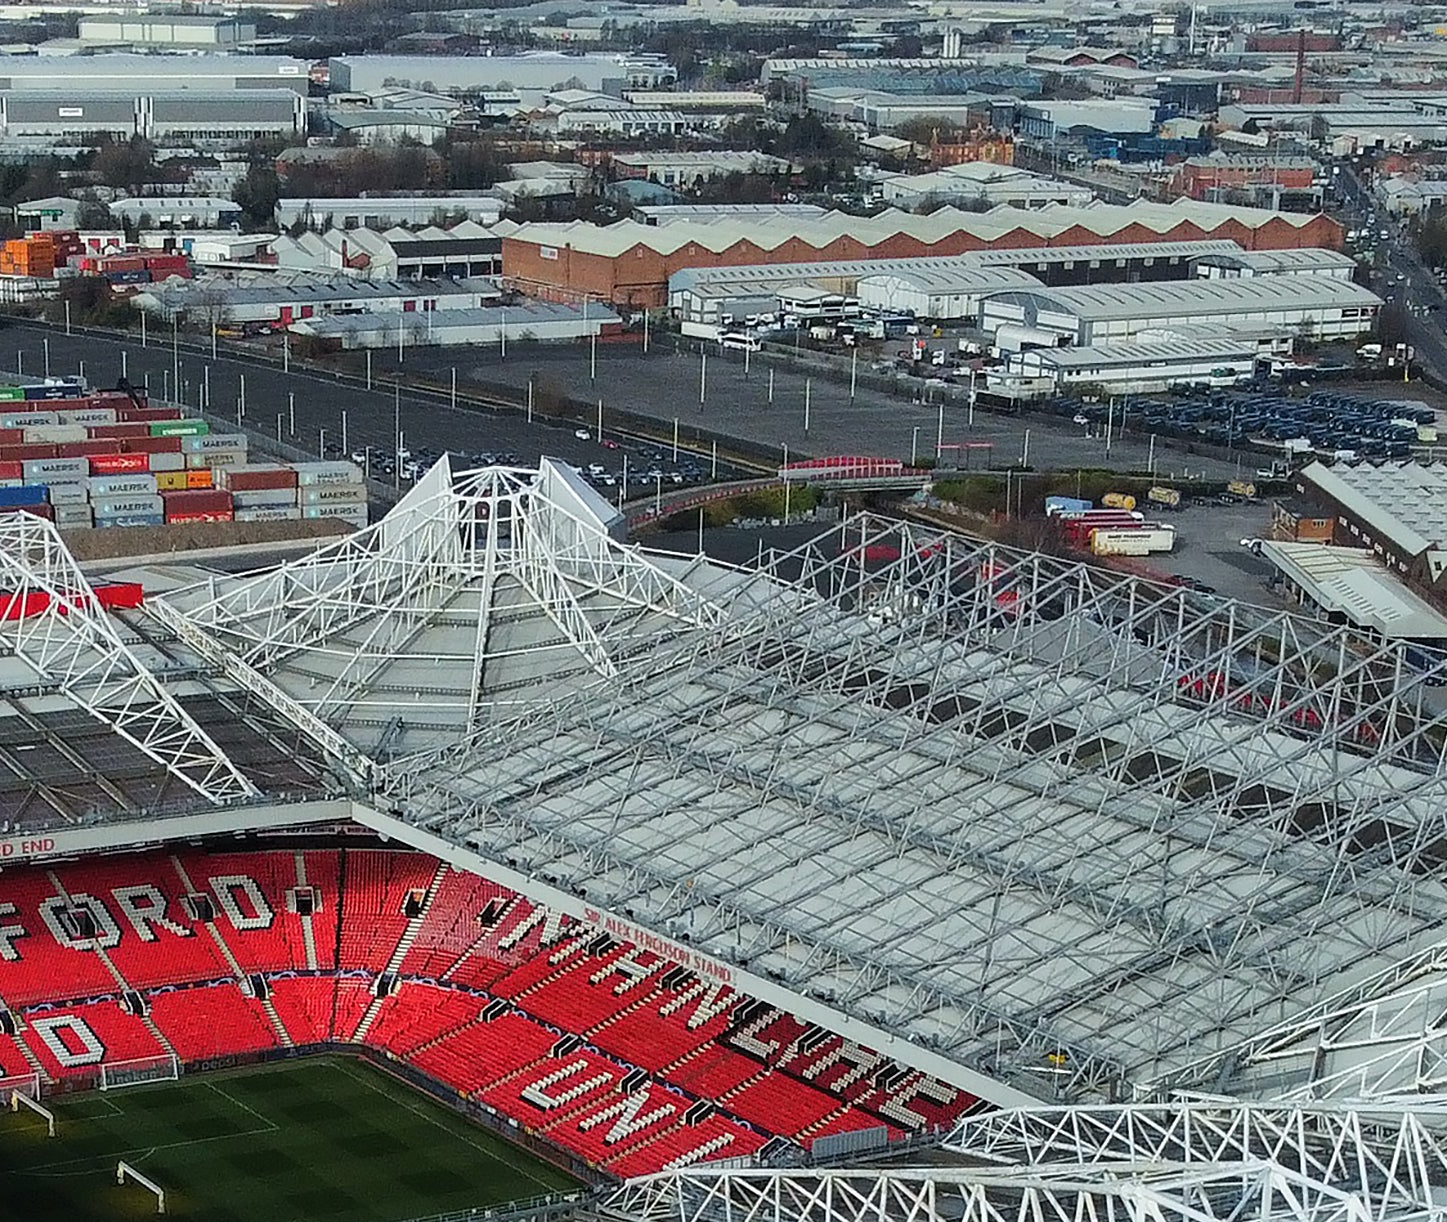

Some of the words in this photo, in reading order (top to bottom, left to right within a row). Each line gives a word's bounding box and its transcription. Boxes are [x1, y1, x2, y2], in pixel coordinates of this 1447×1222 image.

[202, 439, 239, 448] MAERSK
[42, 463, 80, 472] MAERSK
[108, 483, 149, 492] MAERSK
[319, 491, 360, 500] MAERSK
[114, 503, 154, 512] MAERSK
[319, 507, 359, 516] MAERSK
[21, 837, 56, 854] END
[605, 917, 631, 939] ALEX
[634, 929, 691, 965] FERGUSON
[693, 954, 732, 983] STAND
